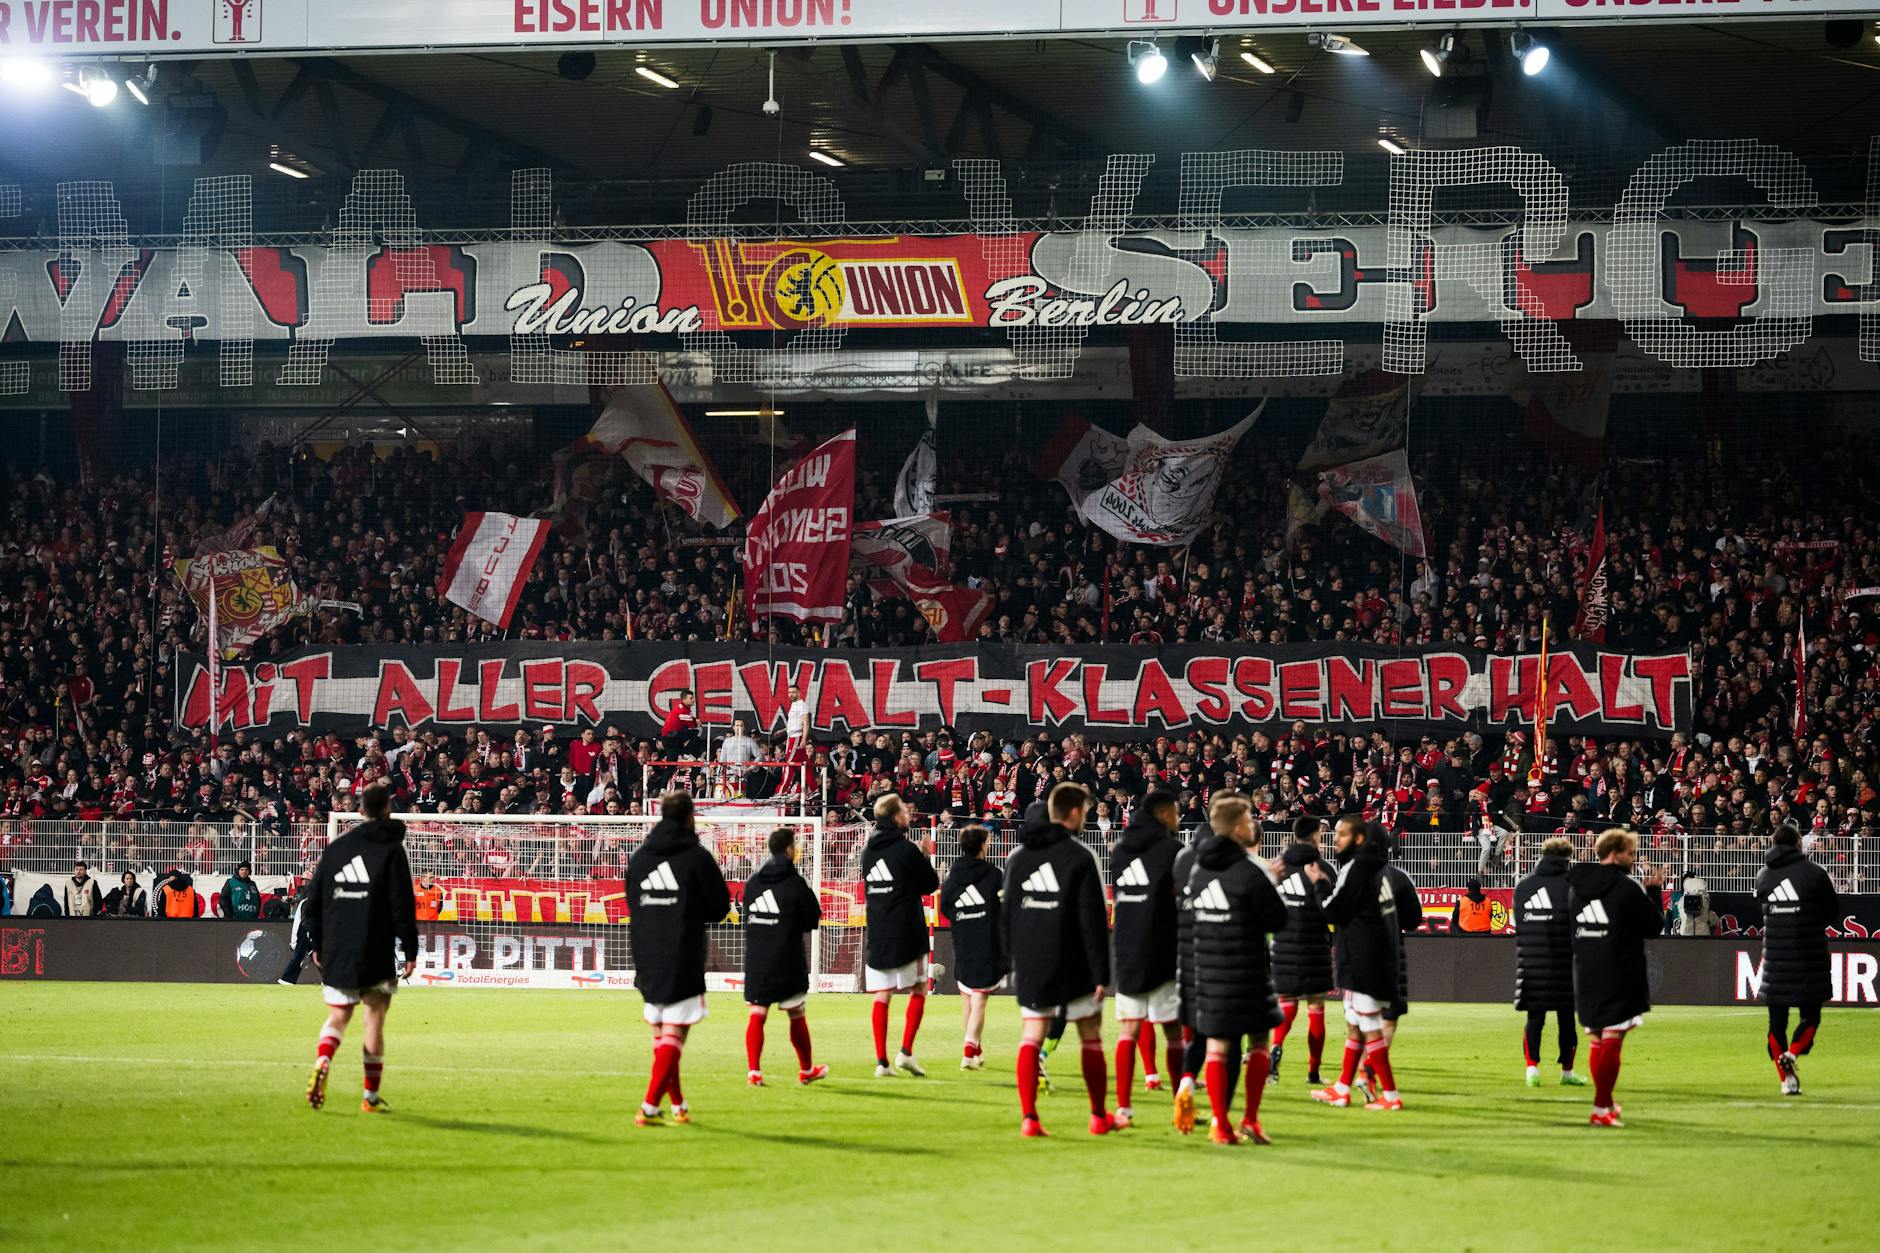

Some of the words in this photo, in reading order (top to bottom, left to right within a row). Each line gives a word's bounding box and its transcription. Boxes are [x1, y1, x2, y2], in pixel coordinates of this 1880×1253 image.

[24, 0, 182, 44] VEREIN.
[514, 0, 663, 33] EISERN
[700, 0, 853, 29] UNION!
[504, 283, 702, 336] Union
[985, 276, 1183, 328] Berlin
[844, 264, 966, 317] UNION
[369, 657, 611, 729] ALLER
[1470, 903, 1485, 911] 101
[493, 936, 605, 971] PITTI
[457, 974, 530, 986] TotalEnergies
